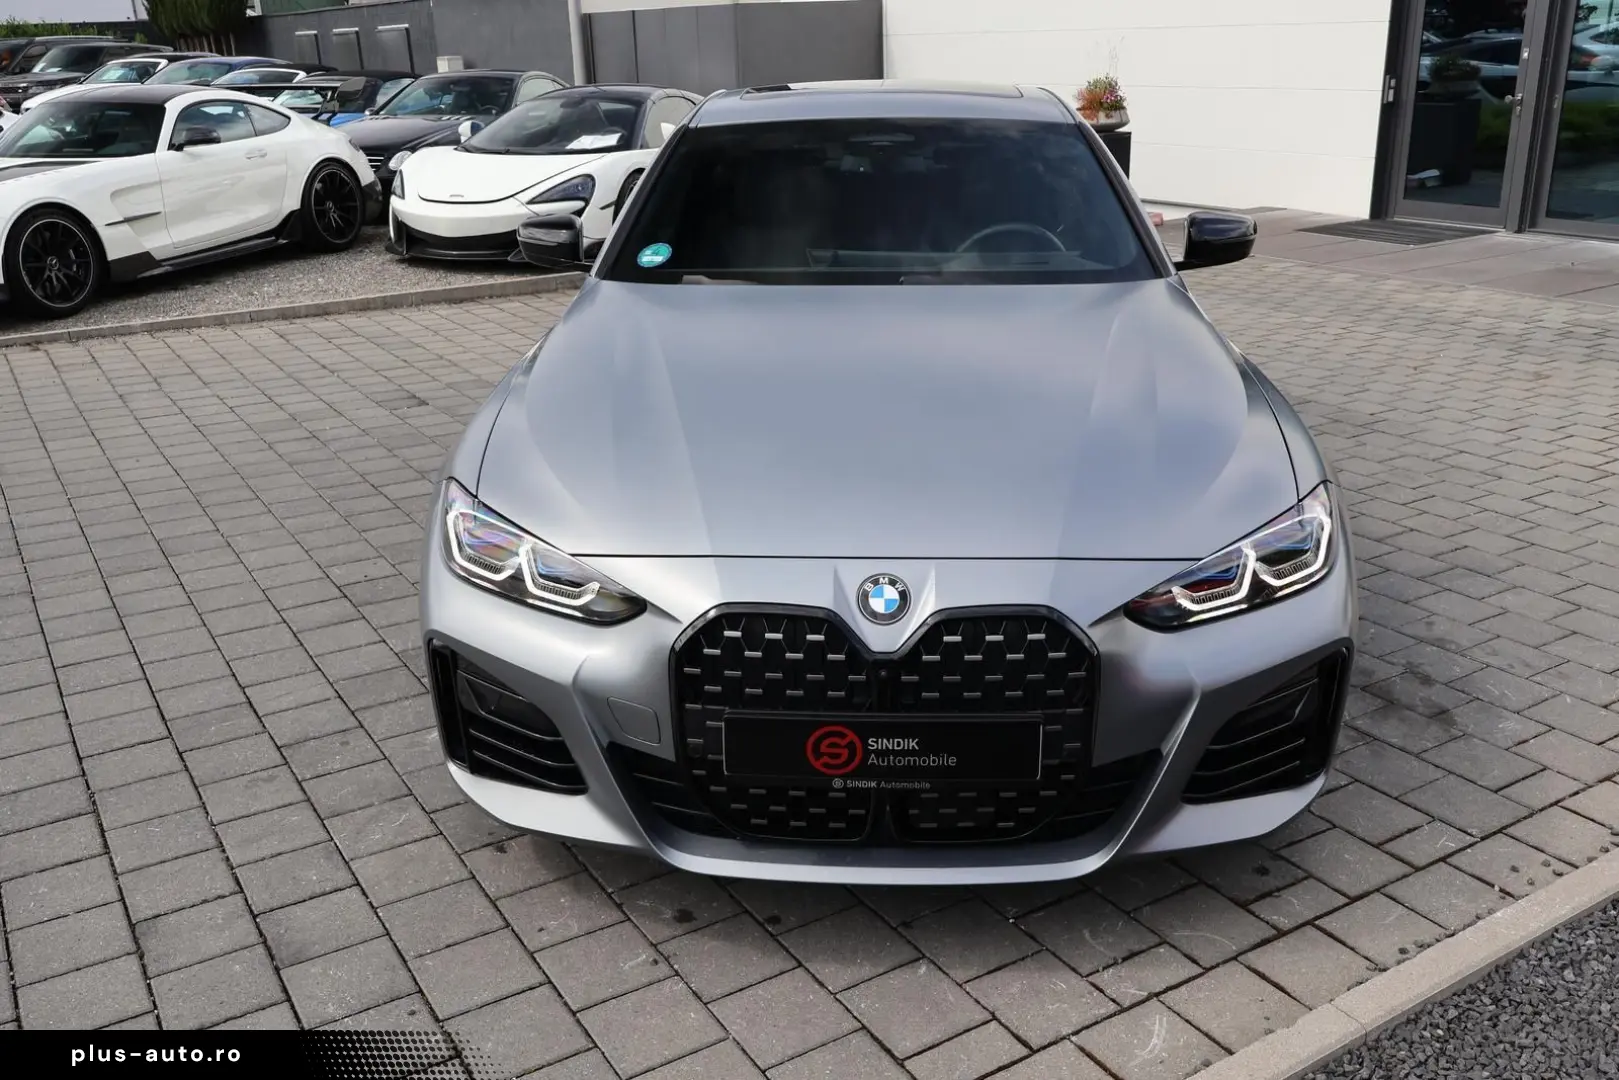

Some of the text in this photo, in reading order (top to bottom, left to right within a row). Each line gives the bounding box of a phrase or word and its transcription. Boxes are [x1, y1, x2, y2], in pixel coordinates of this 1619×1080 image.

[864, 577, 906, 592] BMW
[868, 738, 919, 750] SINDIK
[867, 753, 957, 766] Automobile
[846, 779, 877, 788] SINDIK
[880, 780, 931, 789] Automobile
